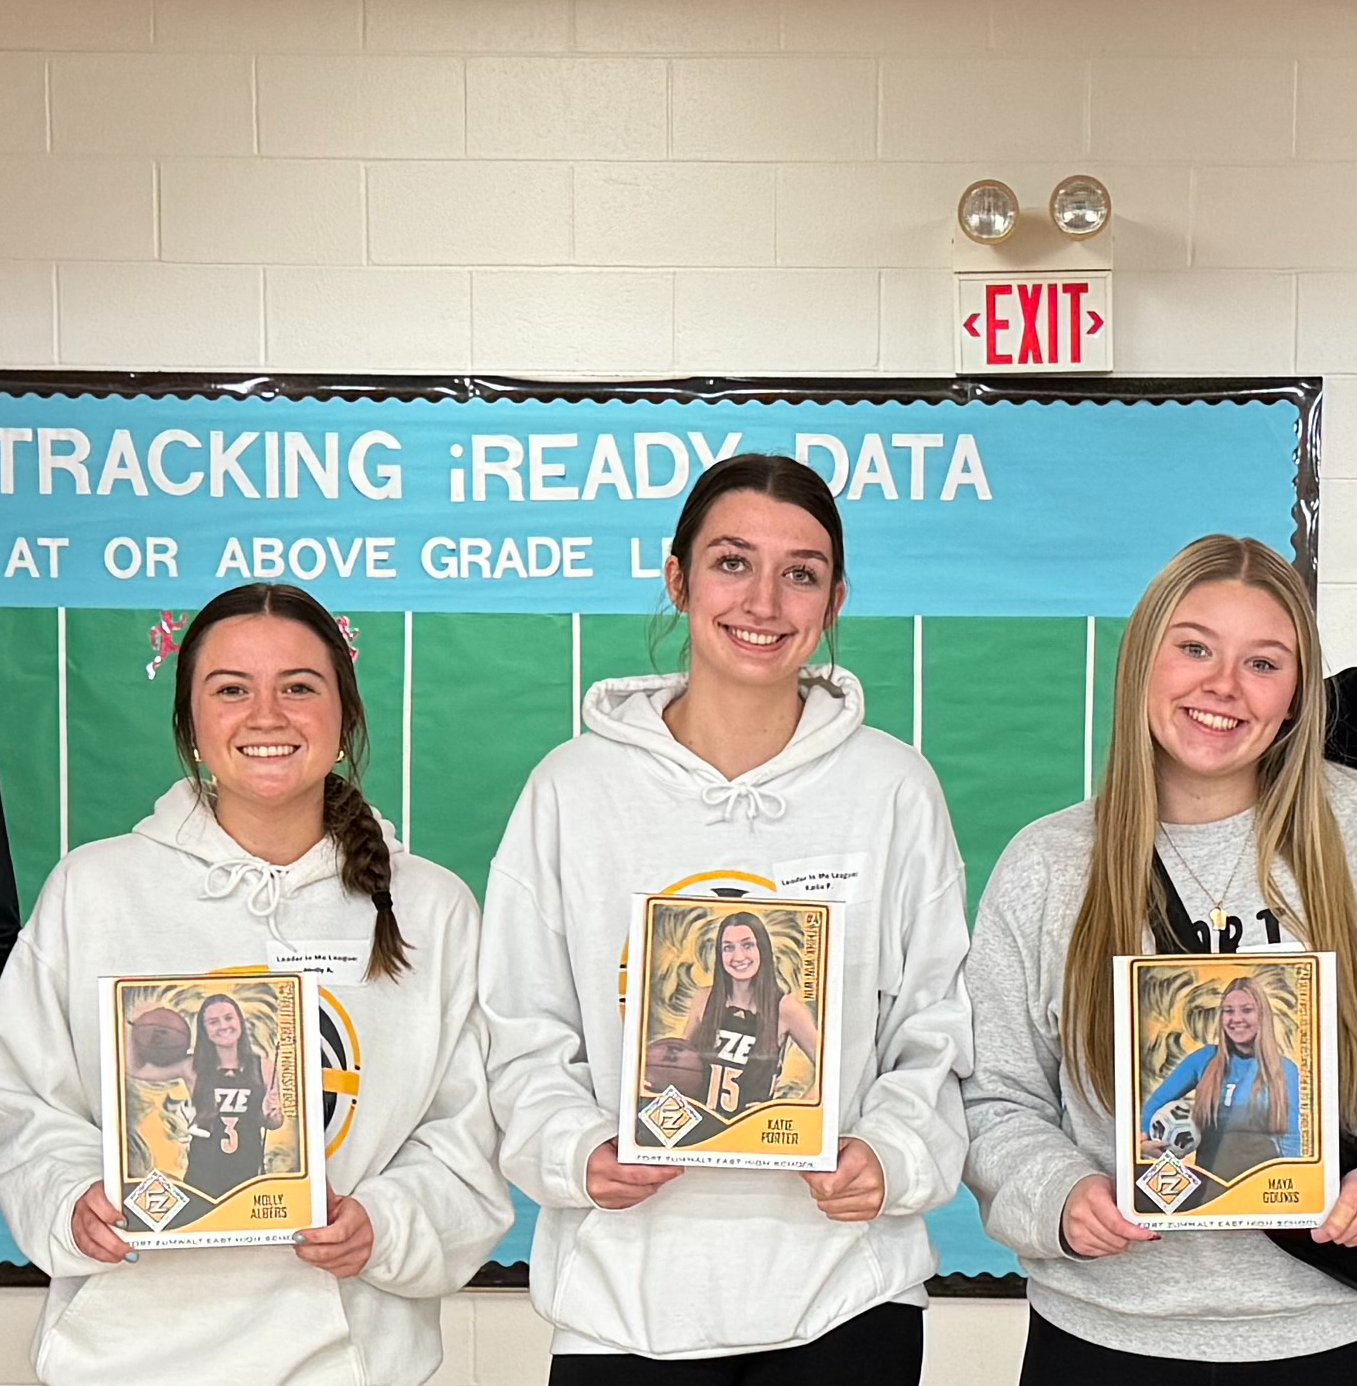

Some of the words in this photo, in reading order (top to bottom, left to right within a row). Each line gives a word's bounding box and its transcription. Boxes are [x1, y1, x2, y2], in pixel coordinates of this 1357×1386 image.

[985, 283, 1089, 365] EXIT
[796, 433, 994, 501] DATA
[3, 537, 69, 579] AT
[103, 537, 178, 579] OR
[215, 537, 397, 580] ABOVE
[420, 536, 593, 579] GRADE
[707, 1064, 743, 1112] 15
[221, 1117, 238, 1153] 3
[767, 1119, 793, 1130] KATIE
[761, 1131, 798, 1144] PORTER
[1268, 1178, 1294, 1190] MAYA
[253, 1194, 284, 1206] MOLLY
[250, 1207, 287, 1219] ALBERS
